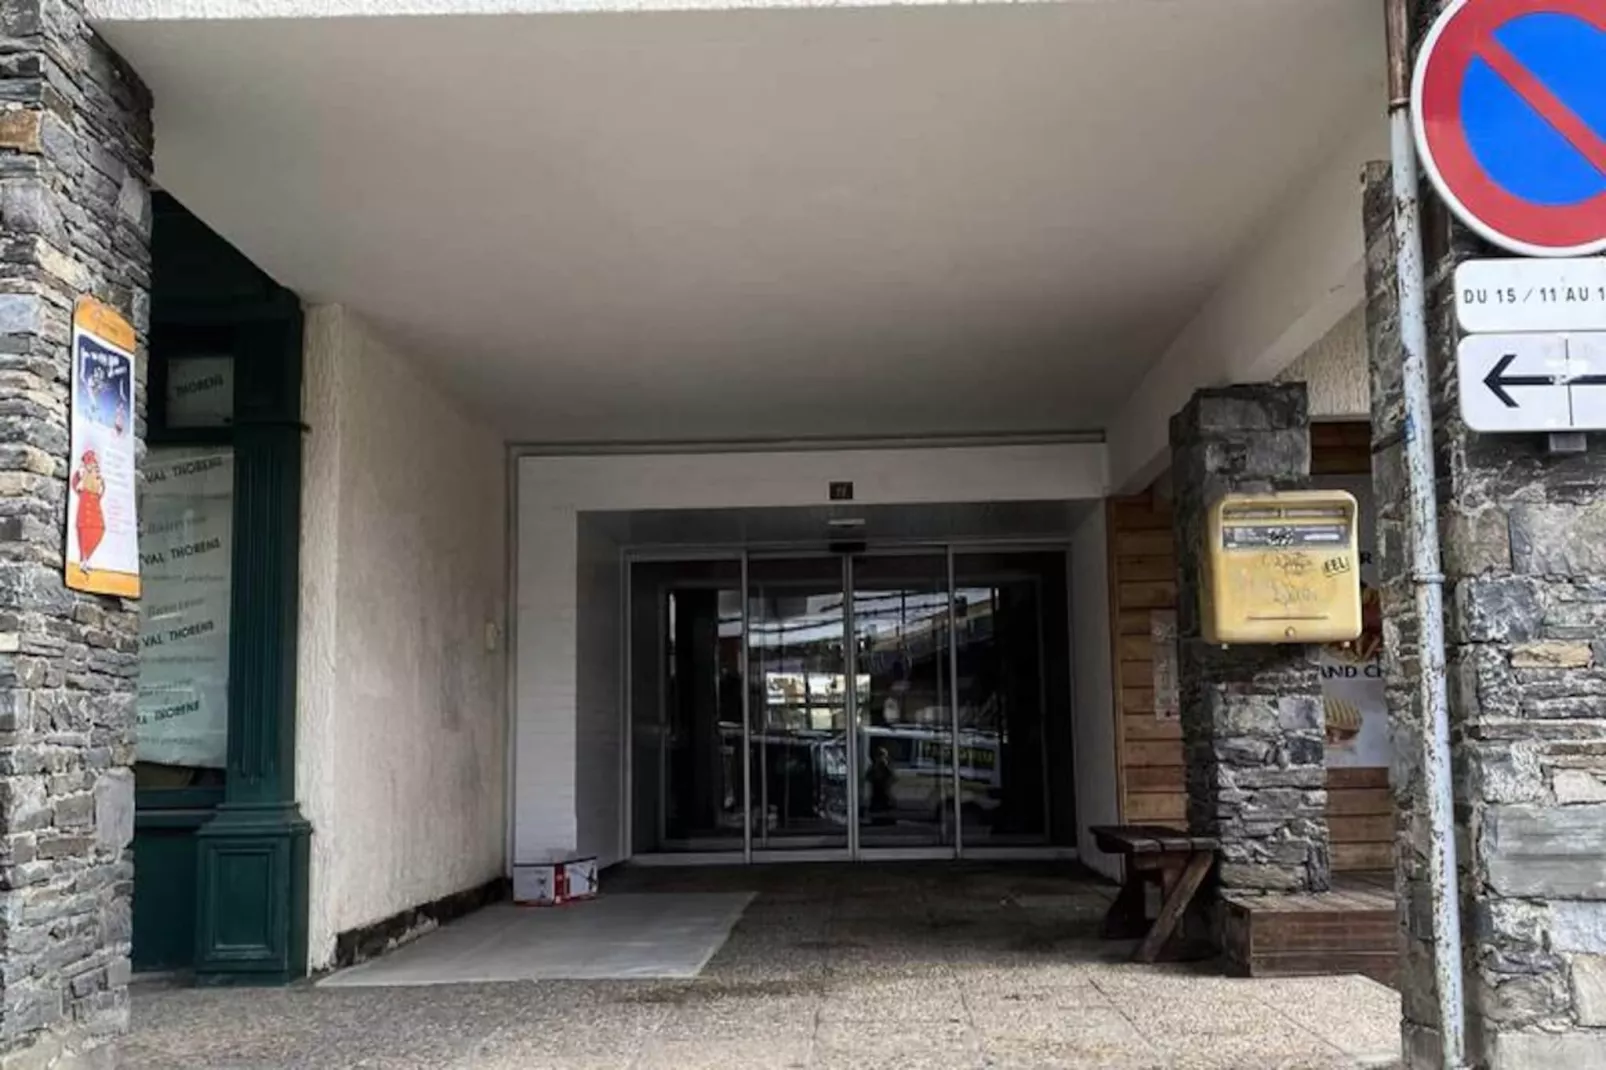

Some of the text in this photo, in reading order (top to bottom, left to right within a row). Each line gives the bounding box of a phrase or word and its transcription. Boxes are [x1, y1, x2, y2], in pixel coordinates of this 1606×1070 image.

[1463, 288, 1487, 304] DU
[1565, 286, 1589, 301] AU
[170, 537, 220, 560] THORENS
[141, 619, 214, 647] VAL THORENS
